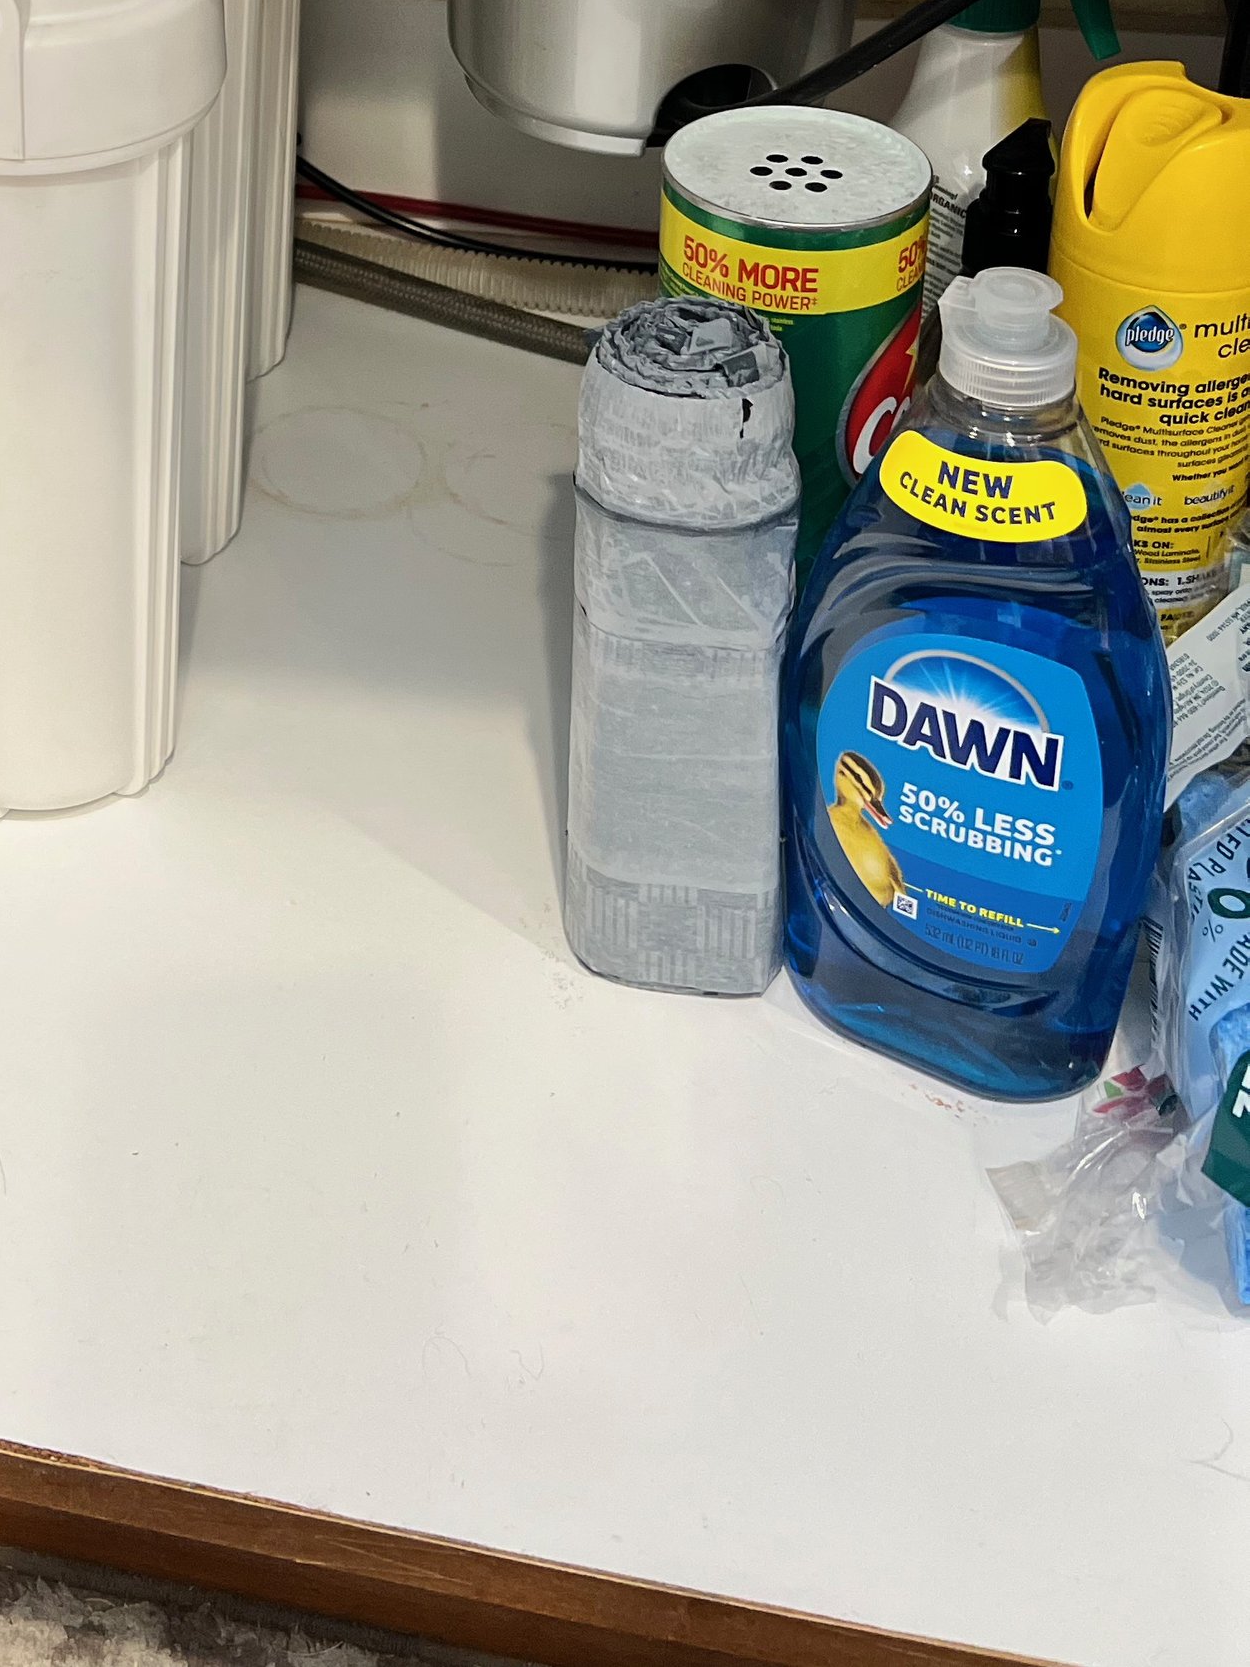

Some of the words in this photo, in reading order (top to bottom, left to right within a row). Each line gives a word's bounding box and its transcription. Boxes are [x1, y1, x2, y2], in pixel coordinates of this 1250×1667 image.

[683, 234, 729, 278] 50%
[738, 258, 819, 294] MORE
[682, 262, 746, 301] CLEANING
[1125, 326, 1174, 346] pledge
[1098, 367, 1189, 396] Removing
[1100, 384, 1142, 405] hard
[1148, 395, 1222, 409] surfaces
[1227, 391, 1238, 403] is
[1143, 426, 1204, 436] Multisurface
[1206, 420, 1238, 434] Cleaner
[1159, 411, 1210, 426] quick
[1112, 443, 1154, 456] surfaces
[1157, 449, 1211, 459] throughout
[1161, 439, 1177, 447] the
[1180, 436, 1222, 447] allergens
[1177, 458, 1216, 468] surfaces
[937, 460, 1013, 499] NEW
[1172, 471, 1211, 482] Whether
[1213, 468, 1227, 479] you
[899, 471, 967, 518] CLEAN
[975, 501, 1055, 525] SCENT
[1137, 525, 1171, 534] almost
[1174, 525, 1200, 534] every
[1161, 516, 1179, 524] has
[1181, 516, 1188, 524] a
[1152, 541, 1174, 549] ON:
[1141, 577, 1169, 586] ONS:
[868, 678, 1062, 790] DAWN
[900, 782, 965, 823] 50%
[975, 807, 1056, 847] LESS
[925, 888, 957, 908] TIME
[959, 900, 977, 914] TO
[979, 907, 1024, 928] REFILL
[1188, 974, 1234, 1022] WITH
